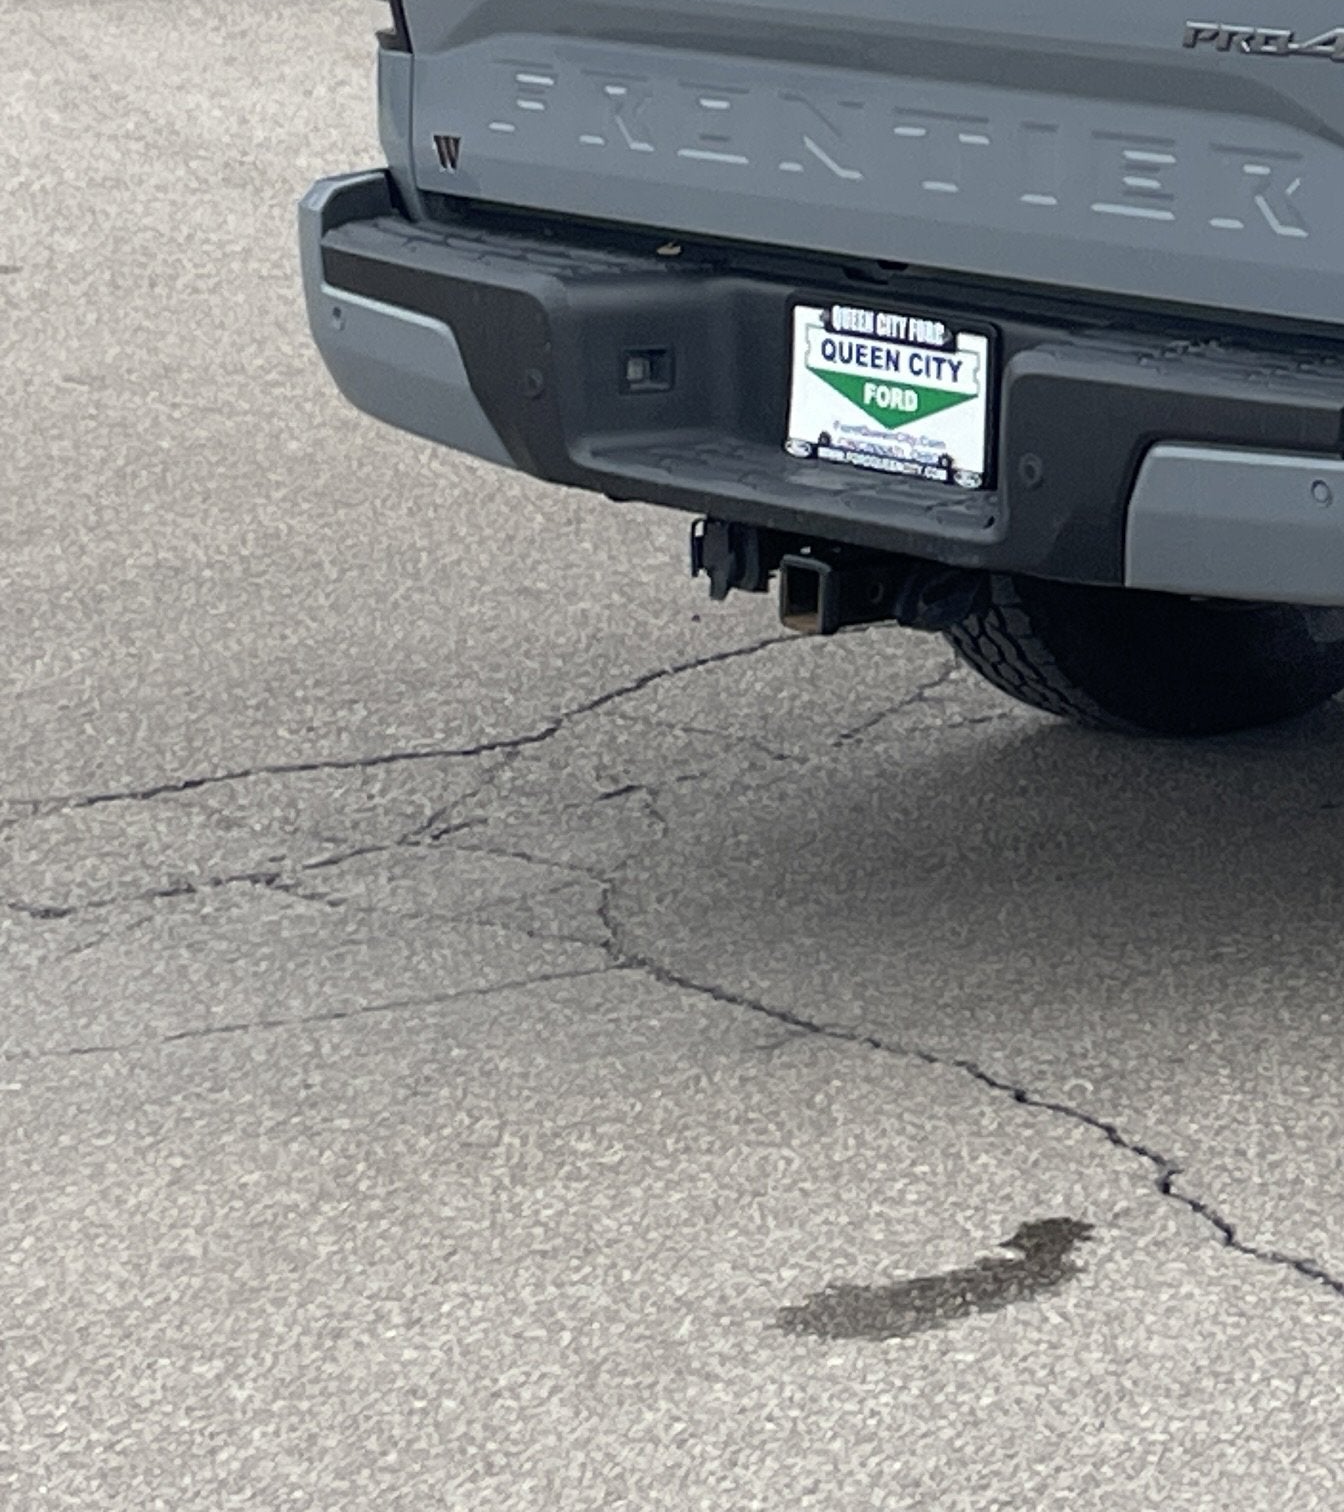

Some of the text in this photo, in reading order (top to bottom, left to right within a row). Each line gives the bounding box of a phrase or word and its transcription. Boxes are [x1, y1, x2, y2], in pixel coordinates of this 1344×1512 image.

[488, 58, 1308, 237] FRONTIER
[831, 304, 875, 334] QUEEN
[876, 312, 908, 340] CITY
[821, 337, 964, 384] QUEEN CITY
[863, 382, 919, 413] FORD
